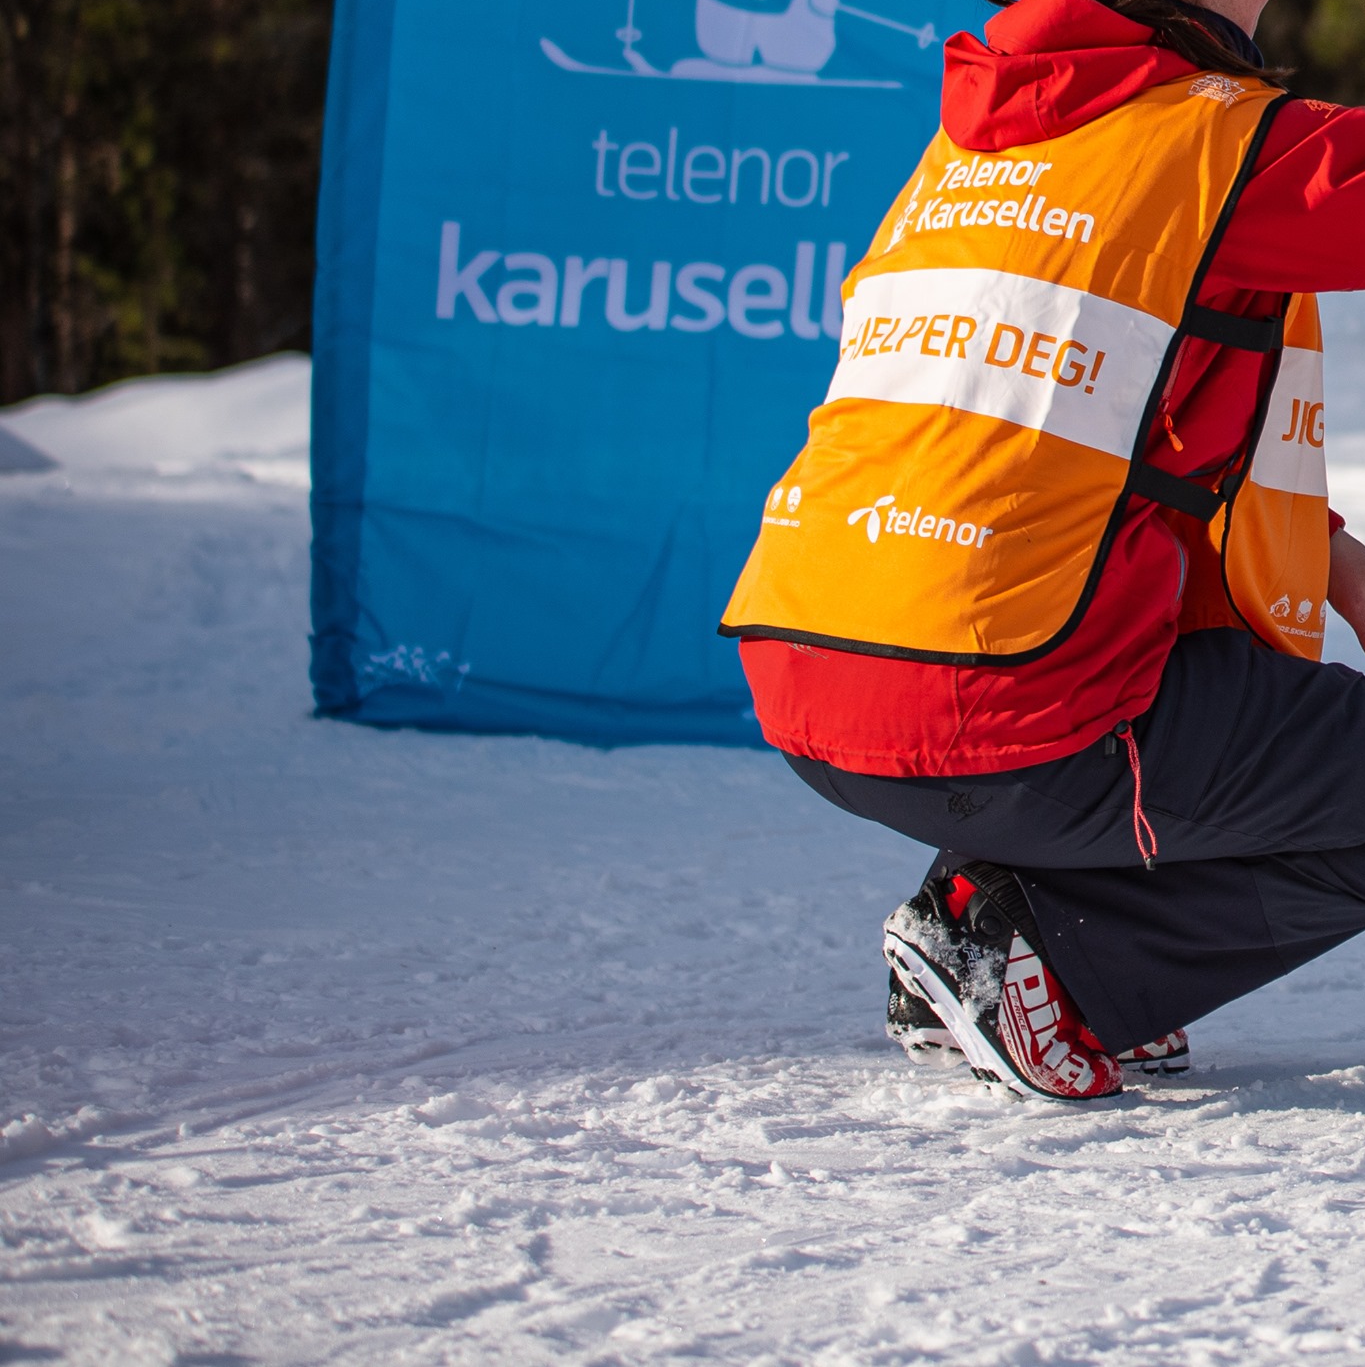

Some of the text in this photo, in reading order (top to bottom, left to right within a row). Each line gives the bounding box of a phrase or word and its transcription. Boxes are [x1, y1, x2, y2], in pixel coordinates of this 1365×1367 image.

[592, 126, 849, 207] telenor
[936, 155, 1053, 192] Telenor
[915, 194, 1095, 244] Karusellen
[984, 322, 1107, 395] DEG!
[885, 506, 993, 549] telenor
